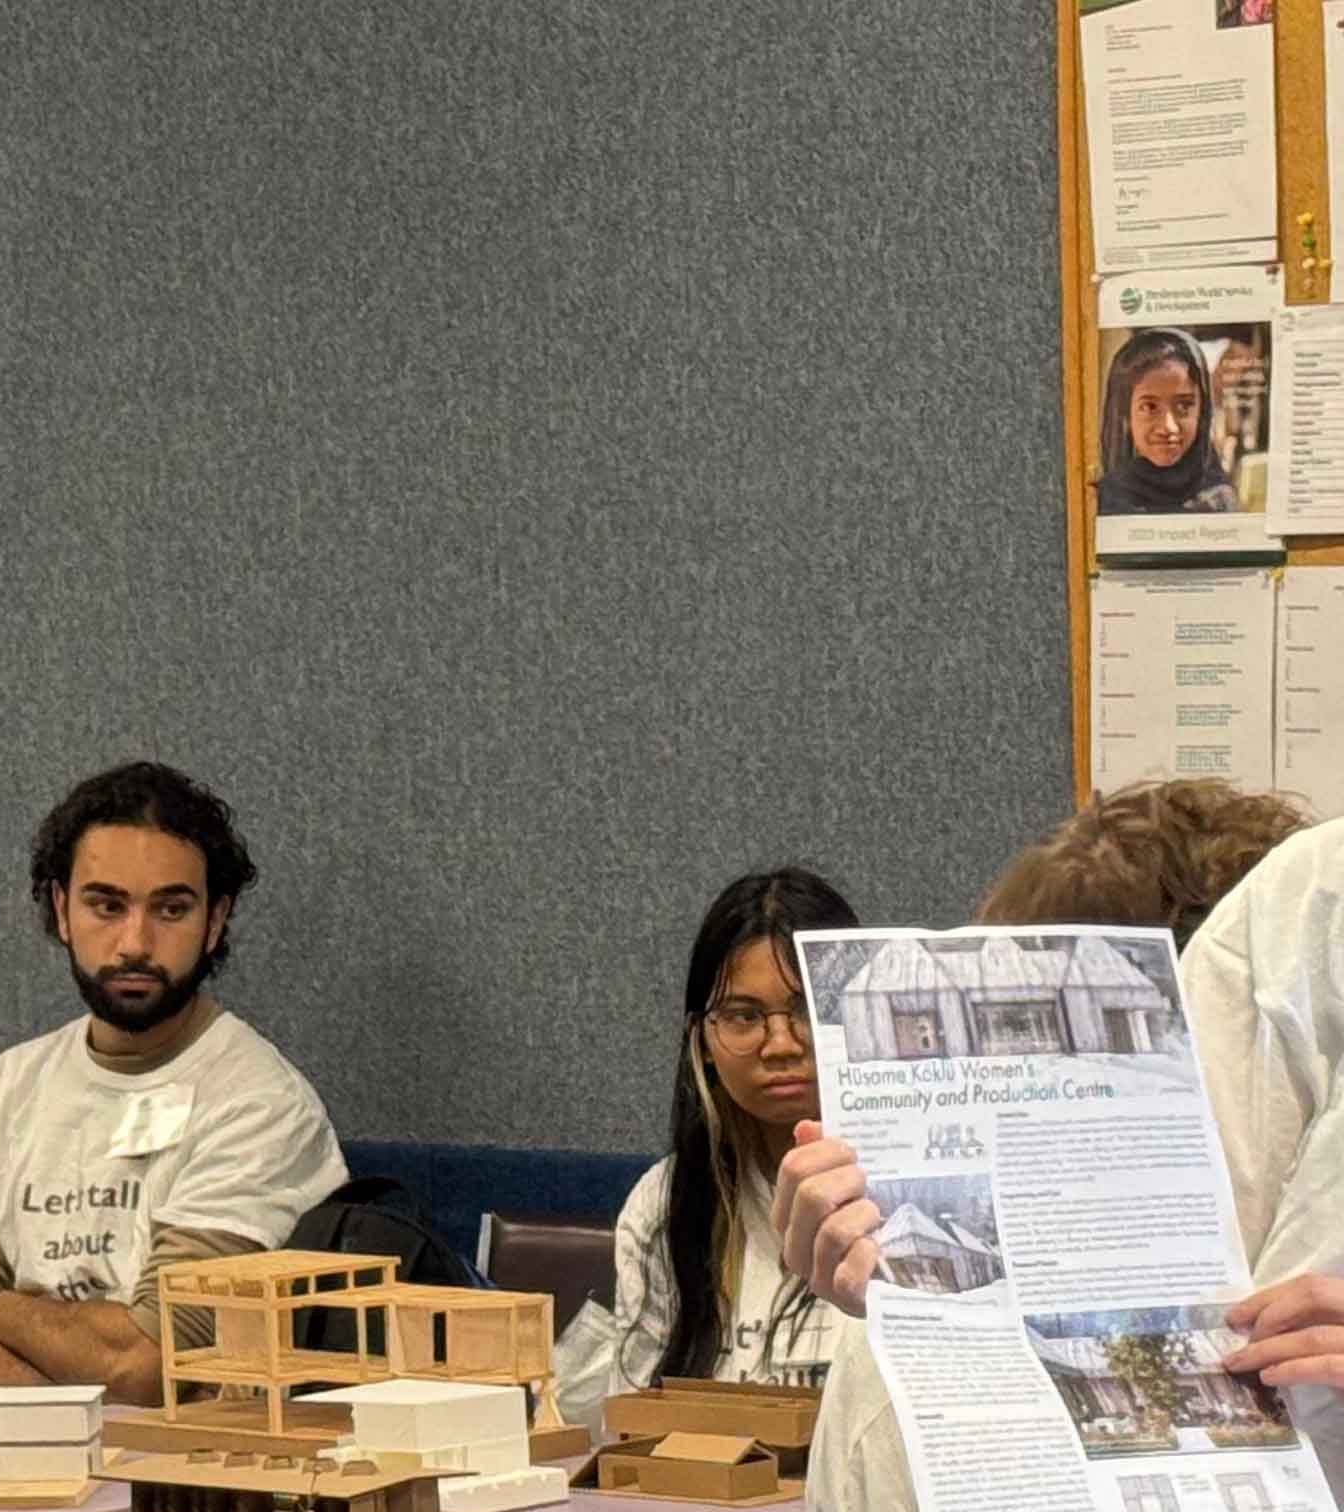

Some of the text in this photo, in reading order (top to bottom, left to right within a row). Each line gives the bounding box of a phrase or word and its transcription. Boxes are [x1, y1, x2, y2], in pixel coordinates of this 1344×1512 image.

[839, 1077, 1116, 1113] Community and Production Centre
